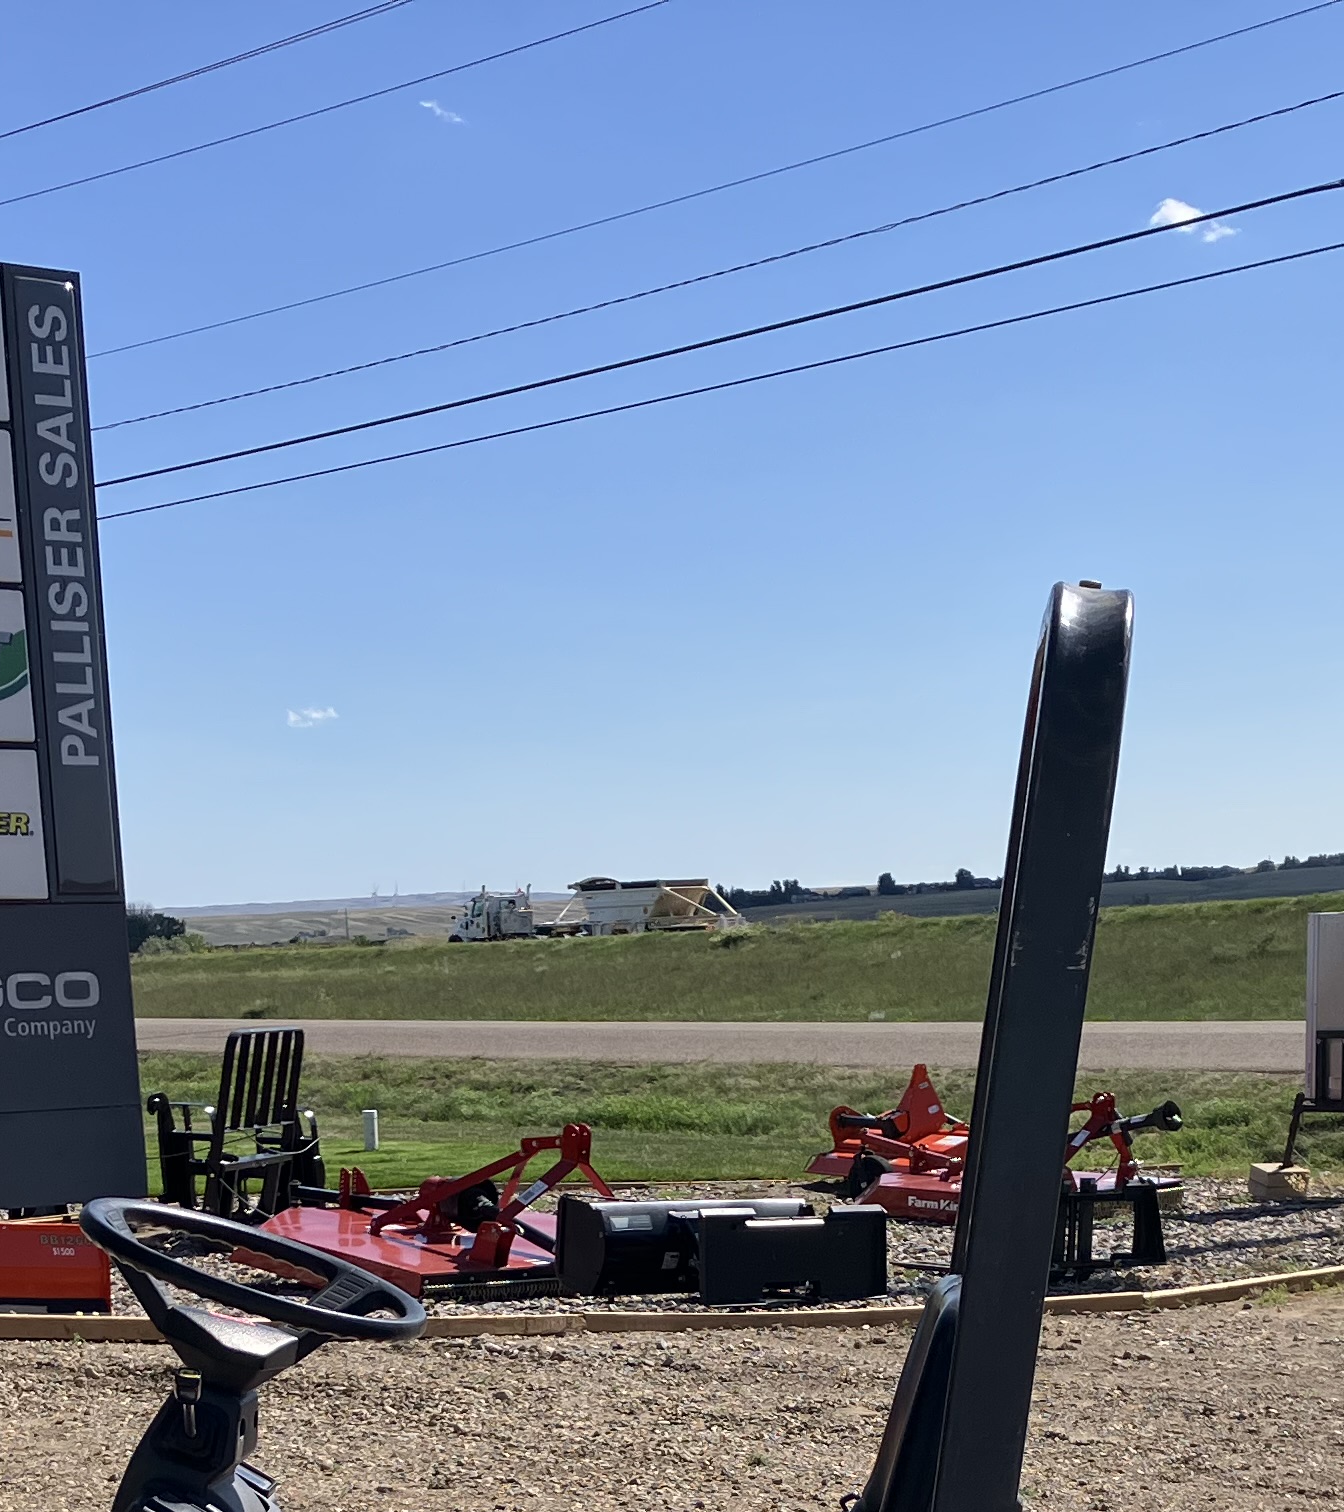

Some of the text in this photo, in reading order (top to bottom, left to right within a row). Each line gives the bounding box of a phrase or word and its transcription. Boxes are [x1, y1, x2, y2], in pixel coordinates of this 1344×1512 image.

[27, 301, 102, 769] PALLISER SALES
[3, 1016, 98, 1040] Company
[907, 1195, 938, 1210] Farm
